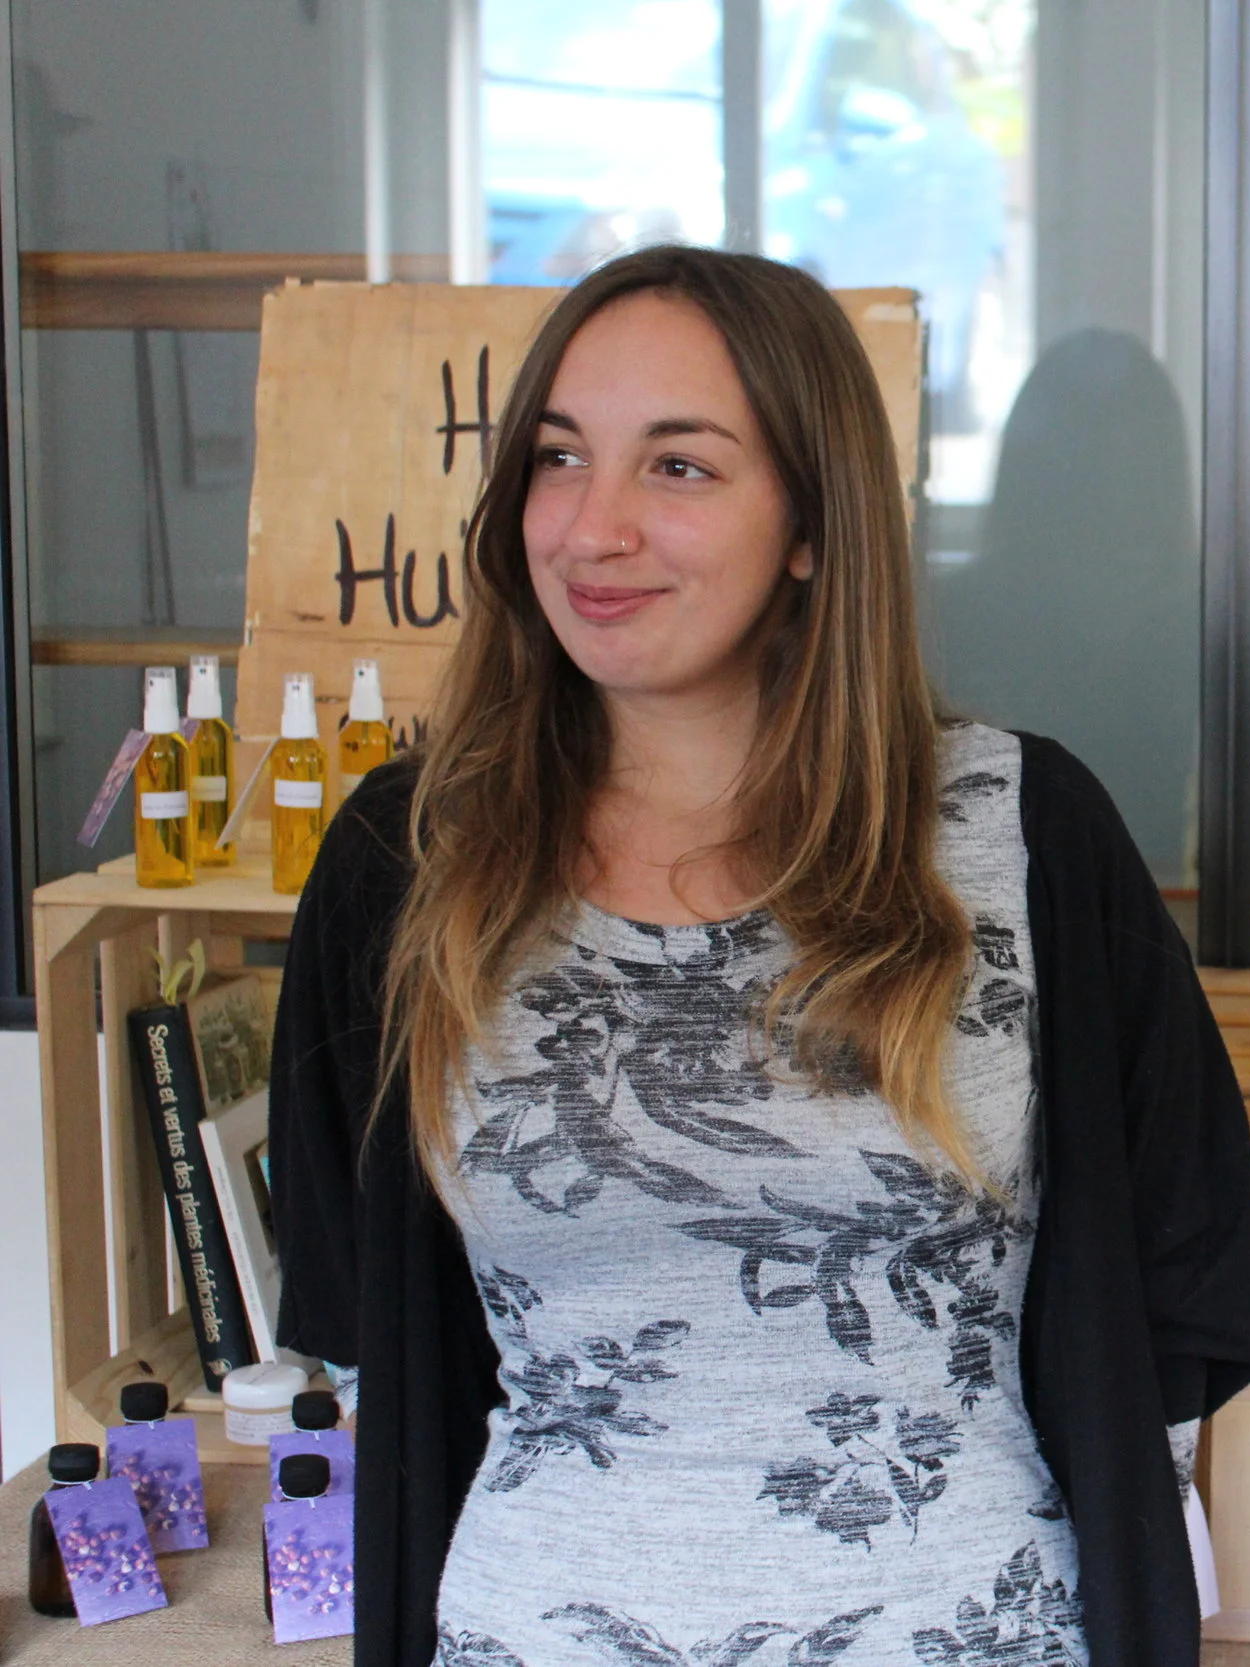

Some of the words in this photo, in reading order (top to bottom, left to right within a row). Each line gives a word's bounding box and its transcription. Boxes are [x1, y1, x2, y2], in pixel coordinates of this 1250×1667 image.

[436, 344, 497, 478] H
[334, 512, 470, 629] Hu
[147, 1023, 174, 1086] Secrets
[159, 1087, 178, 1105] et
[163, 1106, 186, 1158] vertus
[173, 1161, 195, 1190] des
[175, 1193, 203, 1249] plantes
[191, 1252, 223, 1343] médicinales
